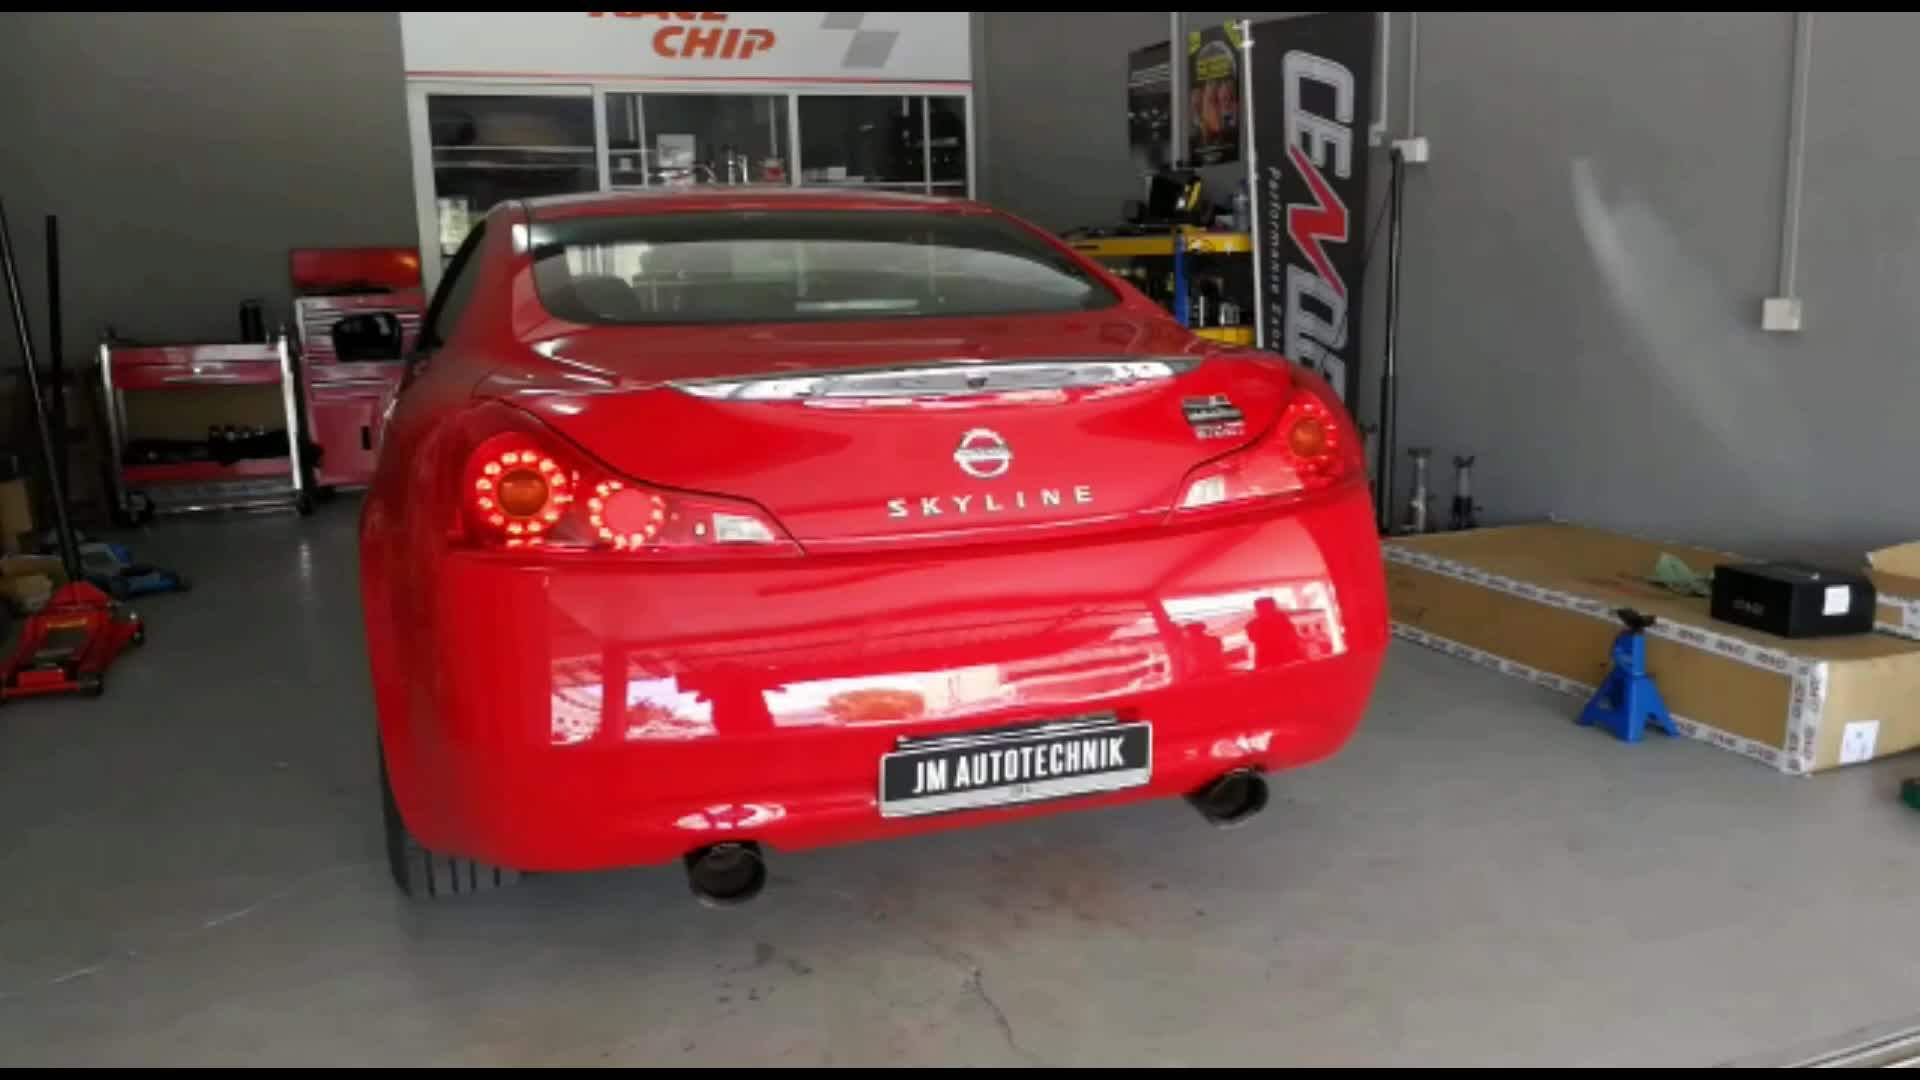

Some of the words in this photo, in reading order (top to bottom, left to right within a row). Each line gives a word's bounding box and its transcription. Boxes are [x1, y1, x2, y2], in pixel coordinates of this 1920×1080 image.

[653, 26, 776, 59] CHIP
[888, 485, 1094, 517] SKYLINE
[913, 758, 947, 793] JM
[954, 736, 1125, 788] AUTOTECHNIK
